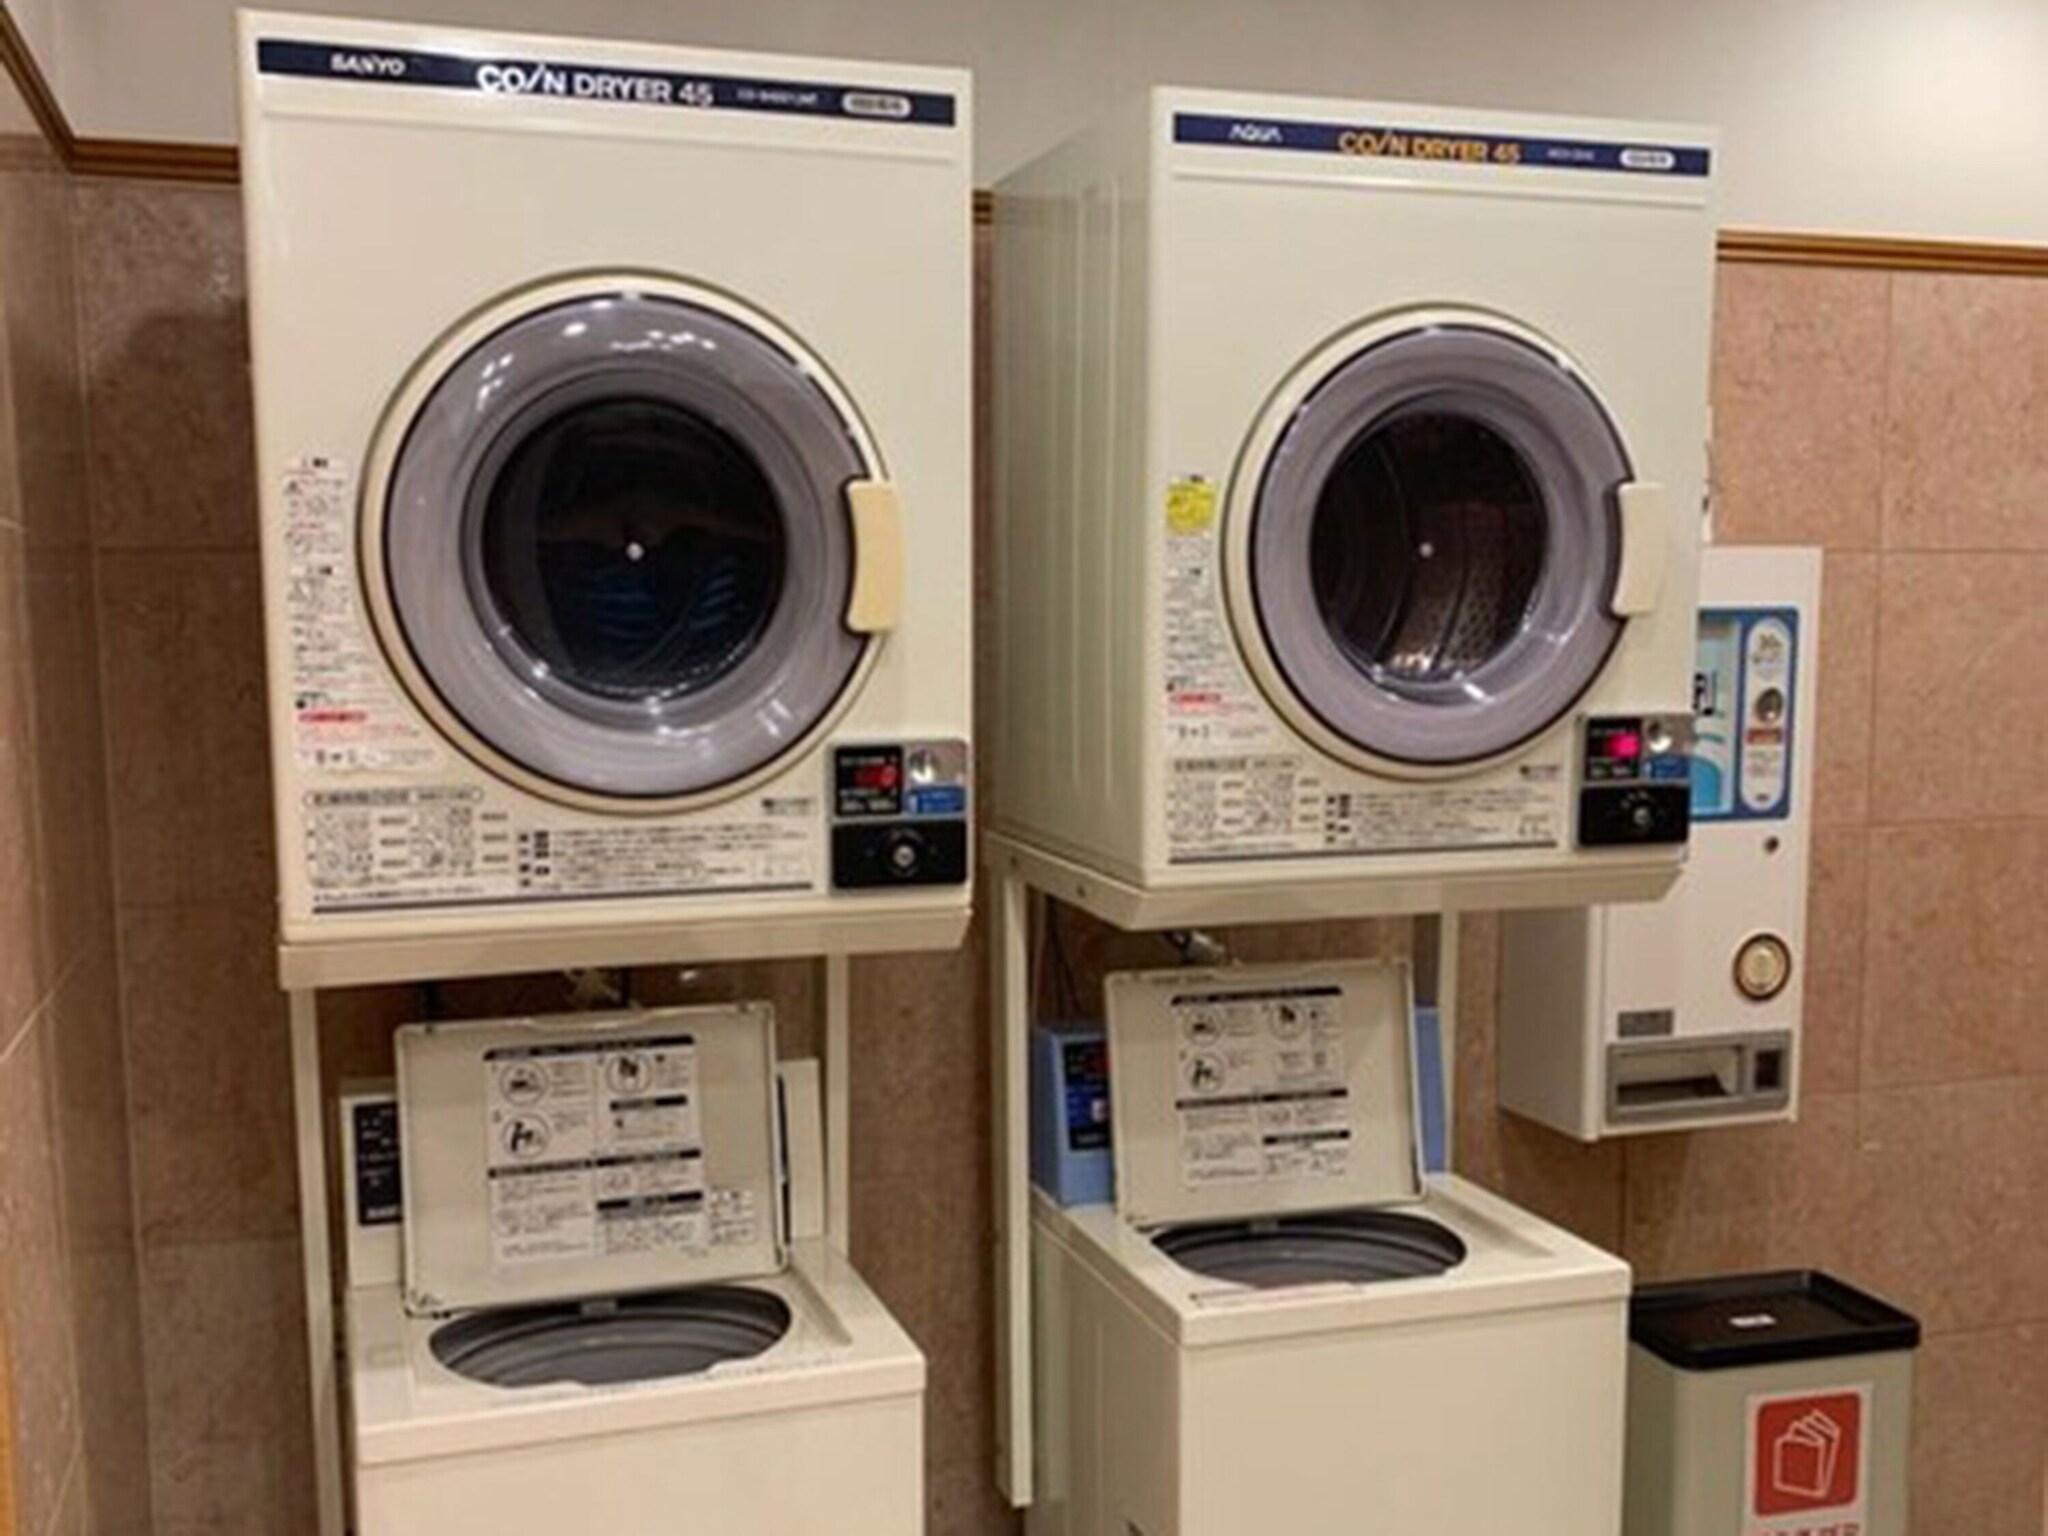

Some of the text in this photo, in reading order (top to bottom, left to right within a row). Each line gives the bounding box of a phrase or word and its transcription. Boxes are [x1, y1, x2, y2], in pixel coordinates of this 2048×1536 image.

[330, 53, 405, 77] SANYO
[573, 73, 672, 104] DRYER
[678, 83, 713, 107] 45
[1229, 123, 1283, 144] AQUA
[1413, 137, 1488, 162] DRYER
